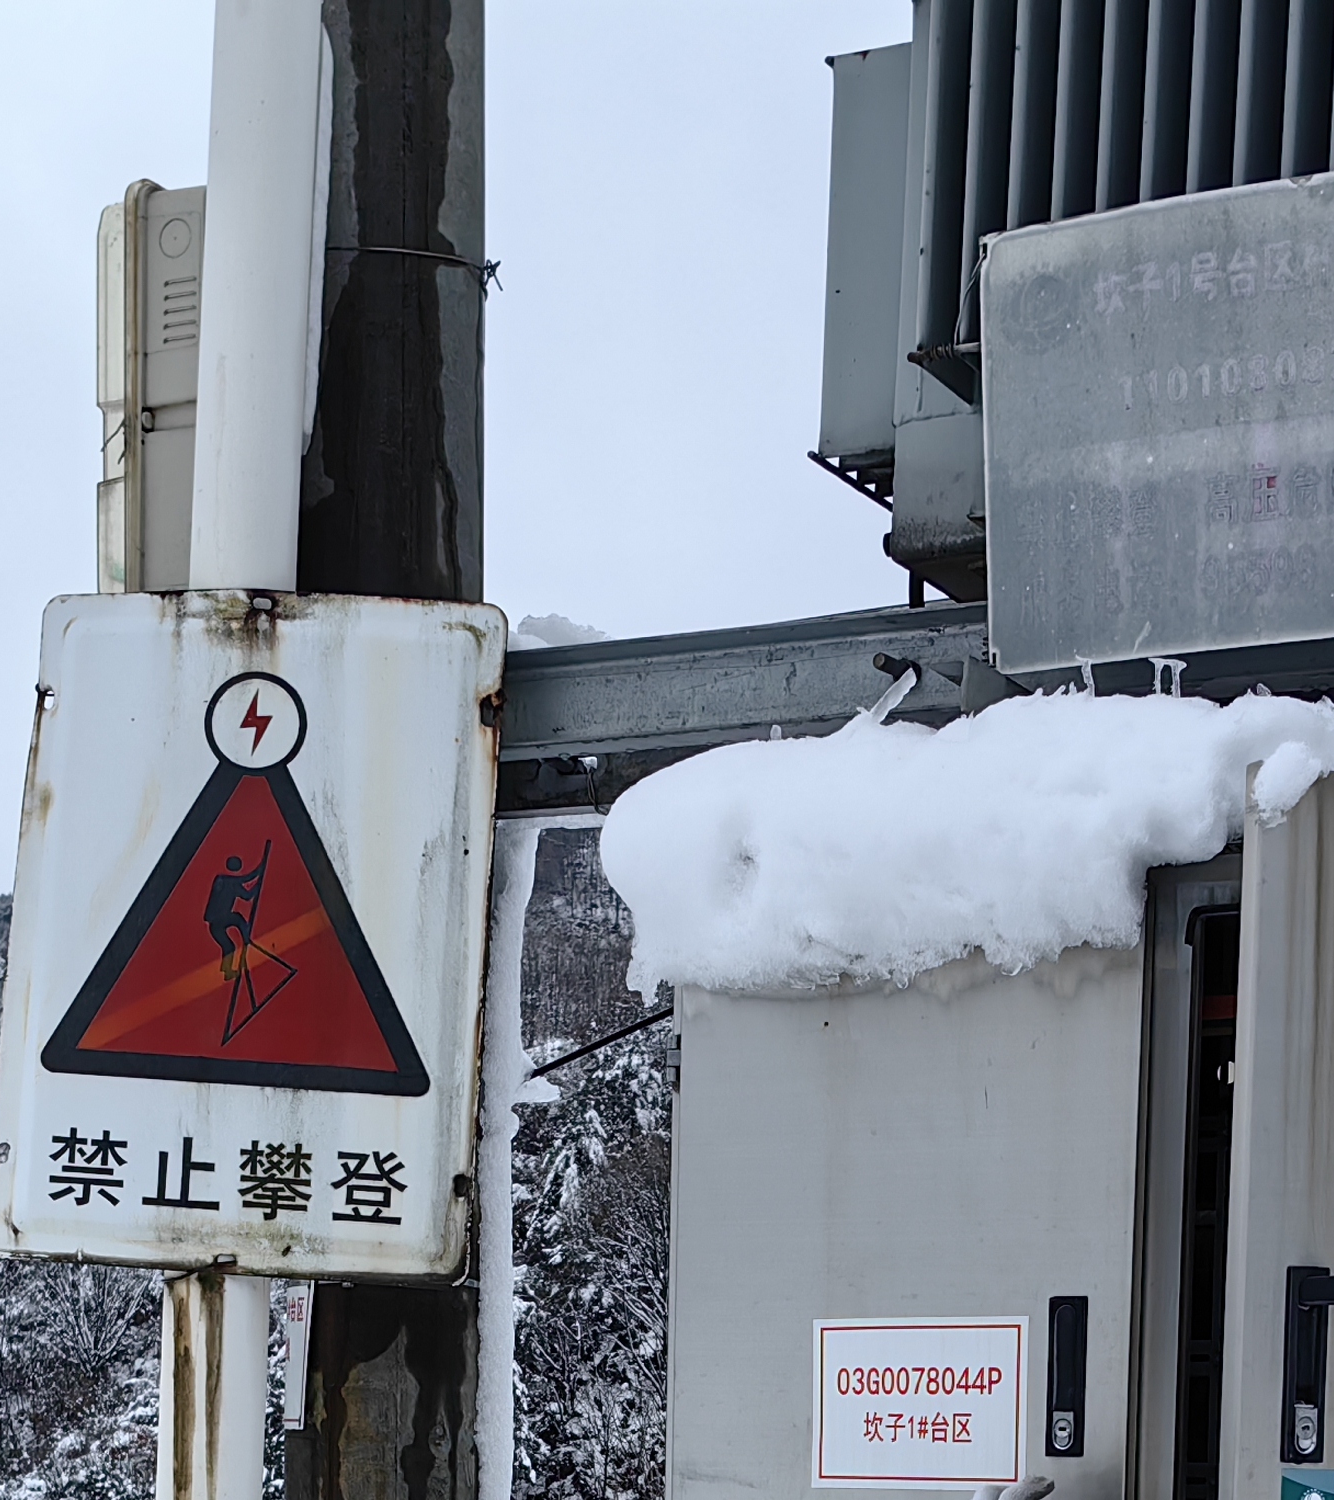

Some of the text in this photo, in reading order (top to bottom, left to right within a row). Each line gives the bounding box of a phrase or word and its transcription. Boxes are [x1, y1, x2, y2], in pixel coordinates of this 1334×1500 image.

[48, 1128, 409, 1225] 禁止攀登
[837, 1367, 1002, 1395] 03G0078044P
[863, 1412, 972, 1443] 坎子1#台区
